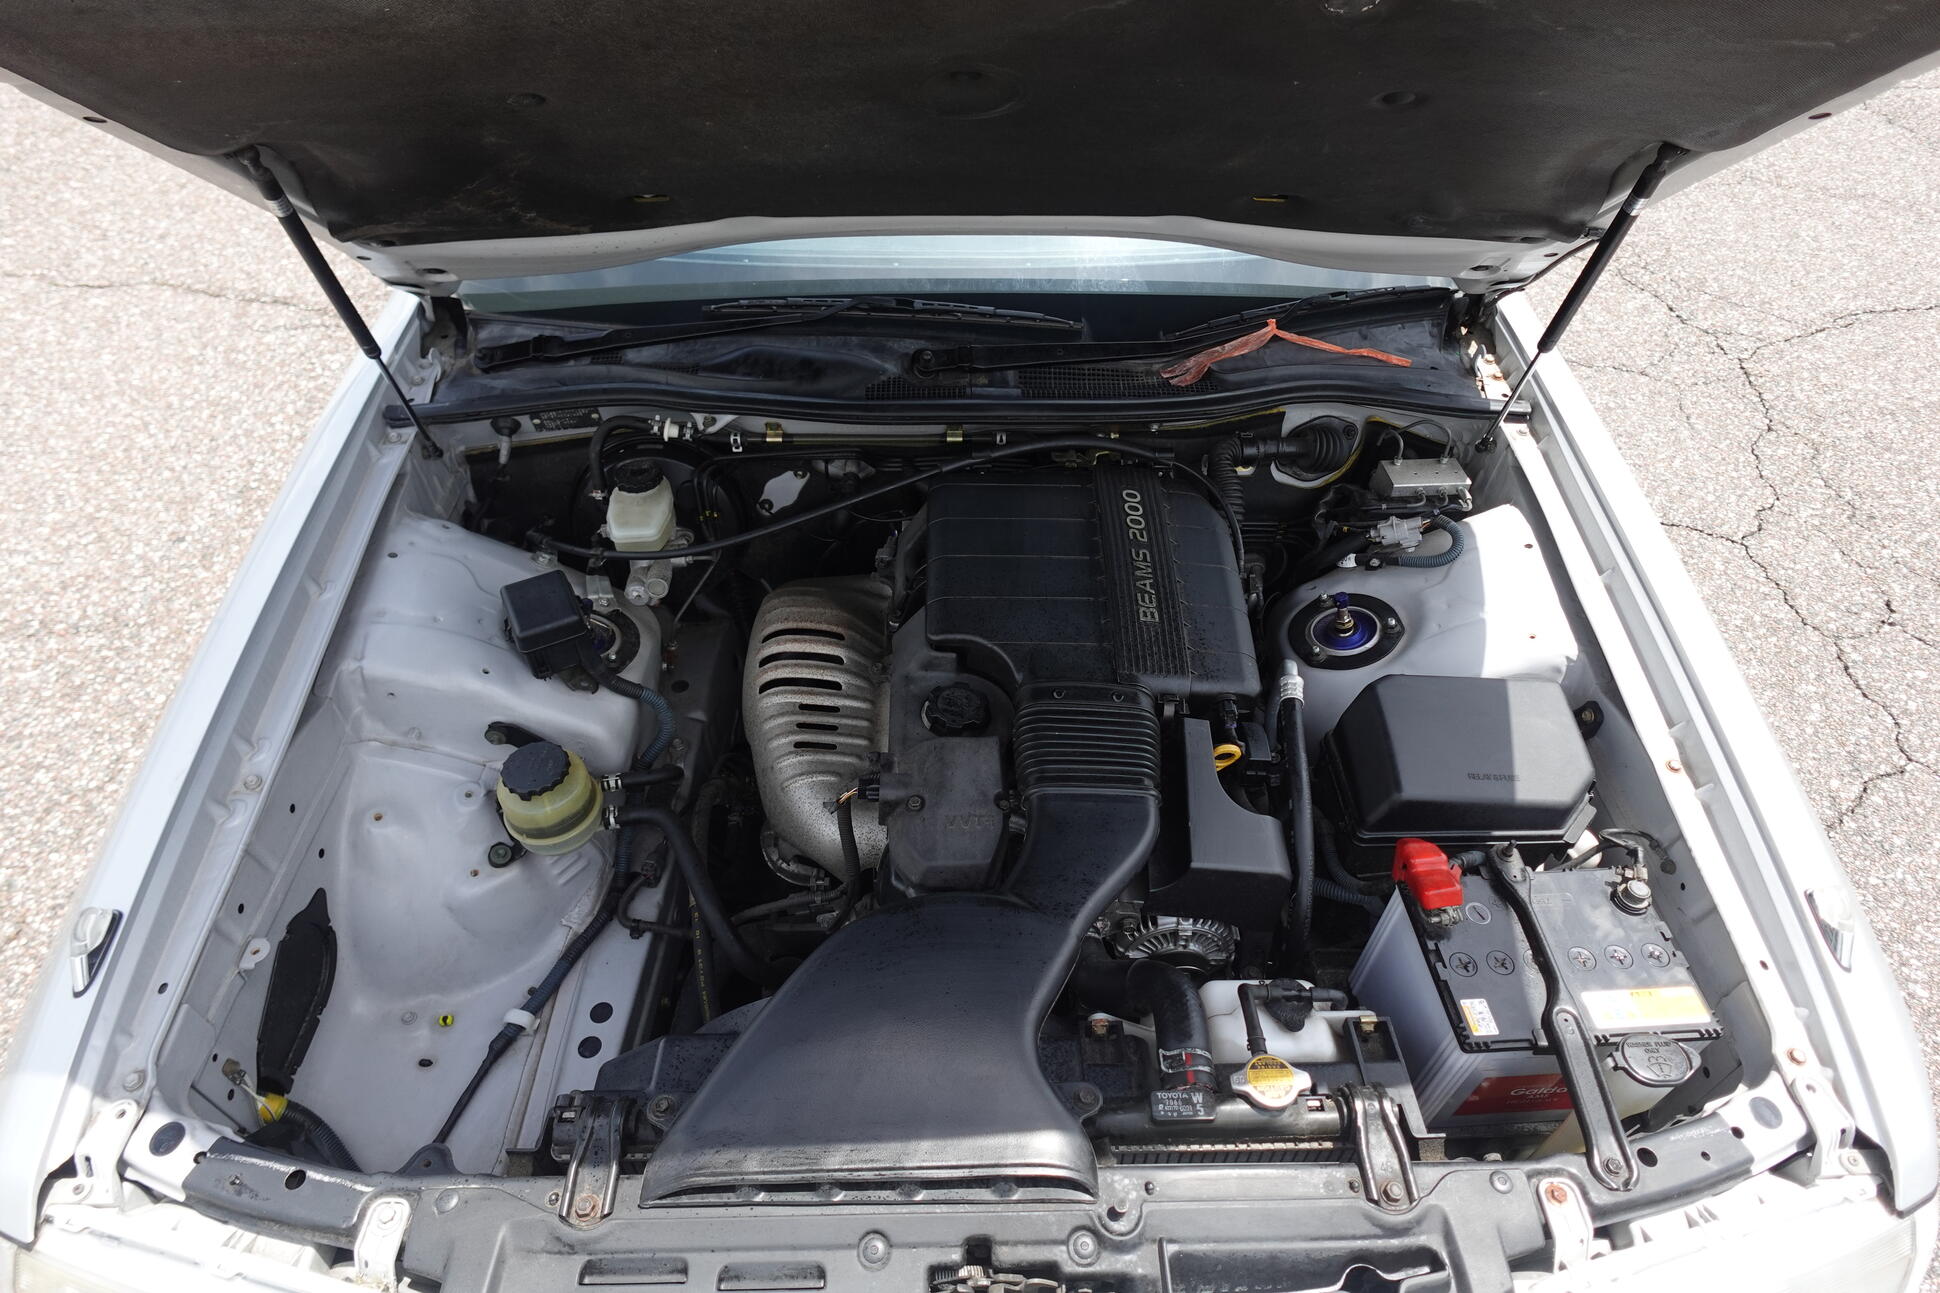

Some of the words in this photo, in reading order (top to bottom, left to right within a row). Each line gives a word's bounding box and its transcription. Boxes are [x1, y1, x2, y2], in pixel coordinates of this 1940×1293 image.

[1122, 489, 1148, 543] 2000
[1132, 548, 1159, 623] BEAMS
[1191, 1092, 1203, 1104] W
[1196, 1103, 1205, 1115] 5
